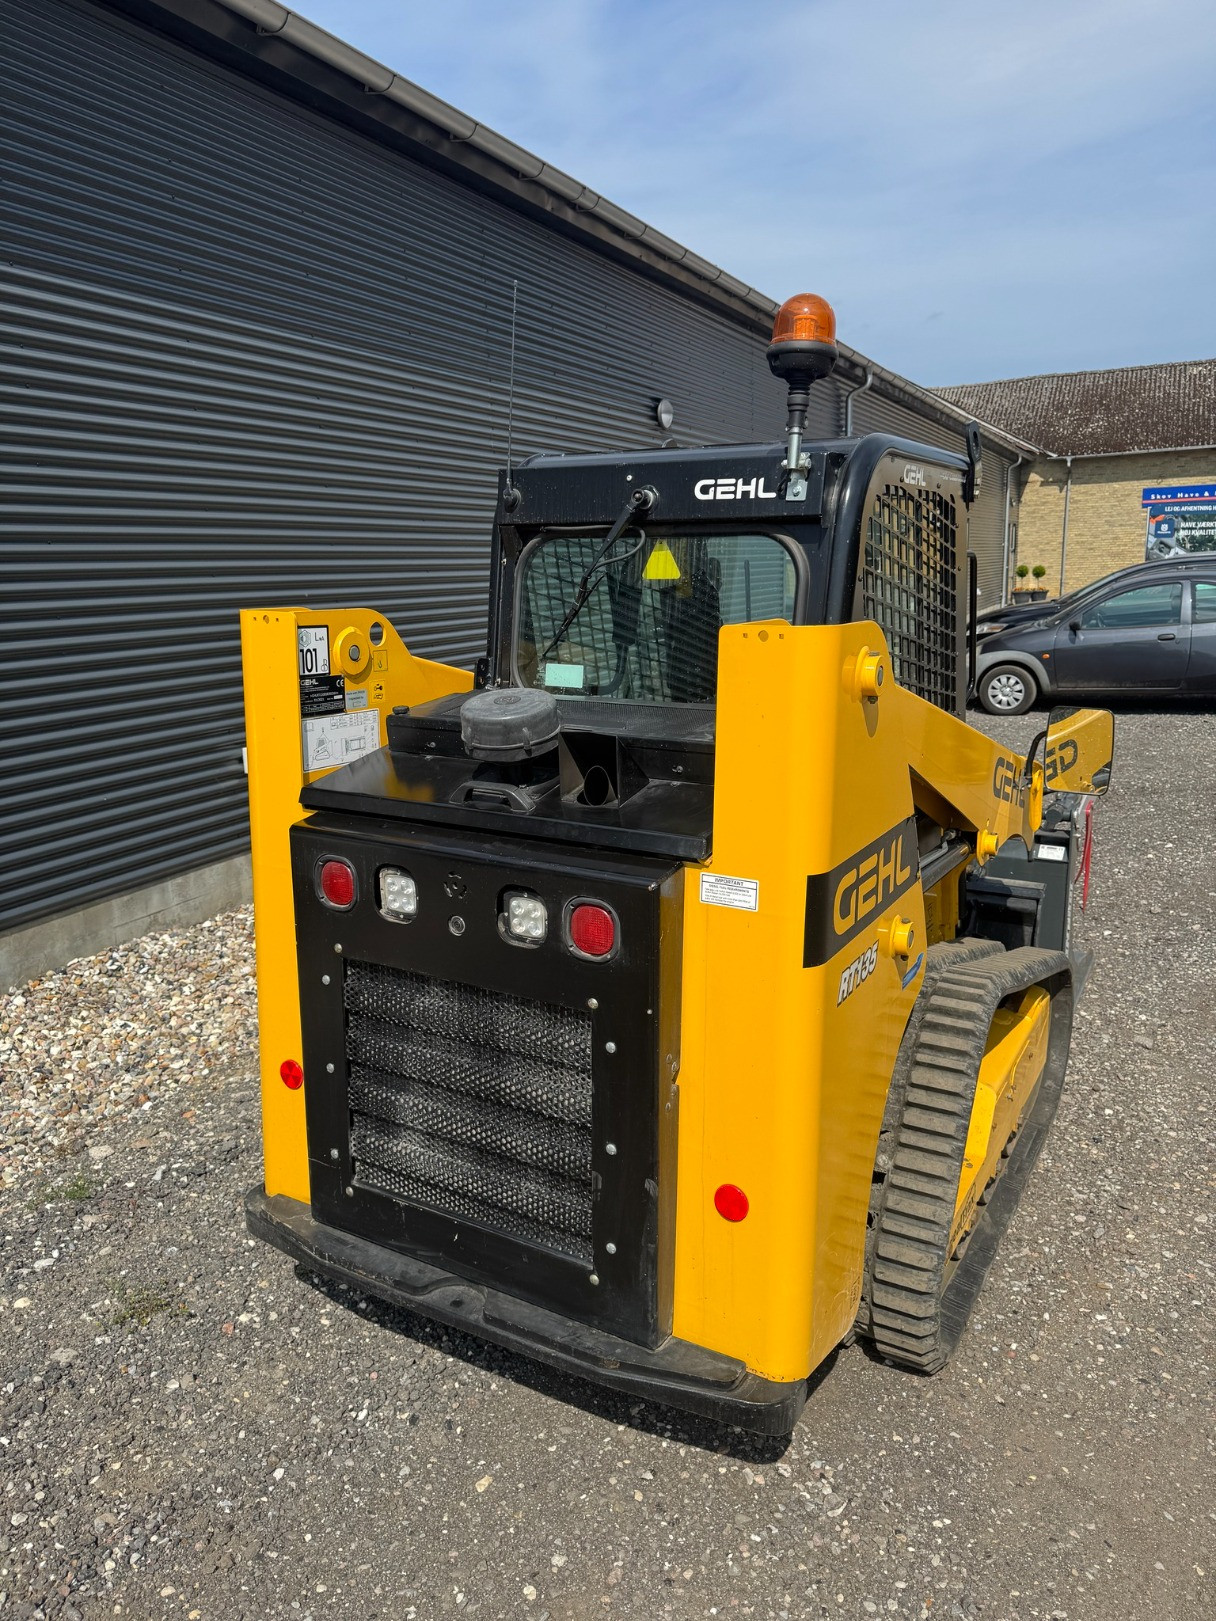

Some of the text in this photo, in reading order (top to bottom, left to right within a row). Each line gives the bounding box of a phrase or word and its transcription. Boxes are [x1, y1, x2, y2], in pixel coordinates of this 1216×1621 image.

[903, 464, 927, 487] GEHL
[694, 477, 777, 500] GEHL
[299, 648, 318, 674] 101
[300, 678, 319, 686] GEHL
[714, 877, 744, 887] IMPORTANT
[833, 834, 911, 936] GEHL
[836, 939, 880, 1008] RT135
